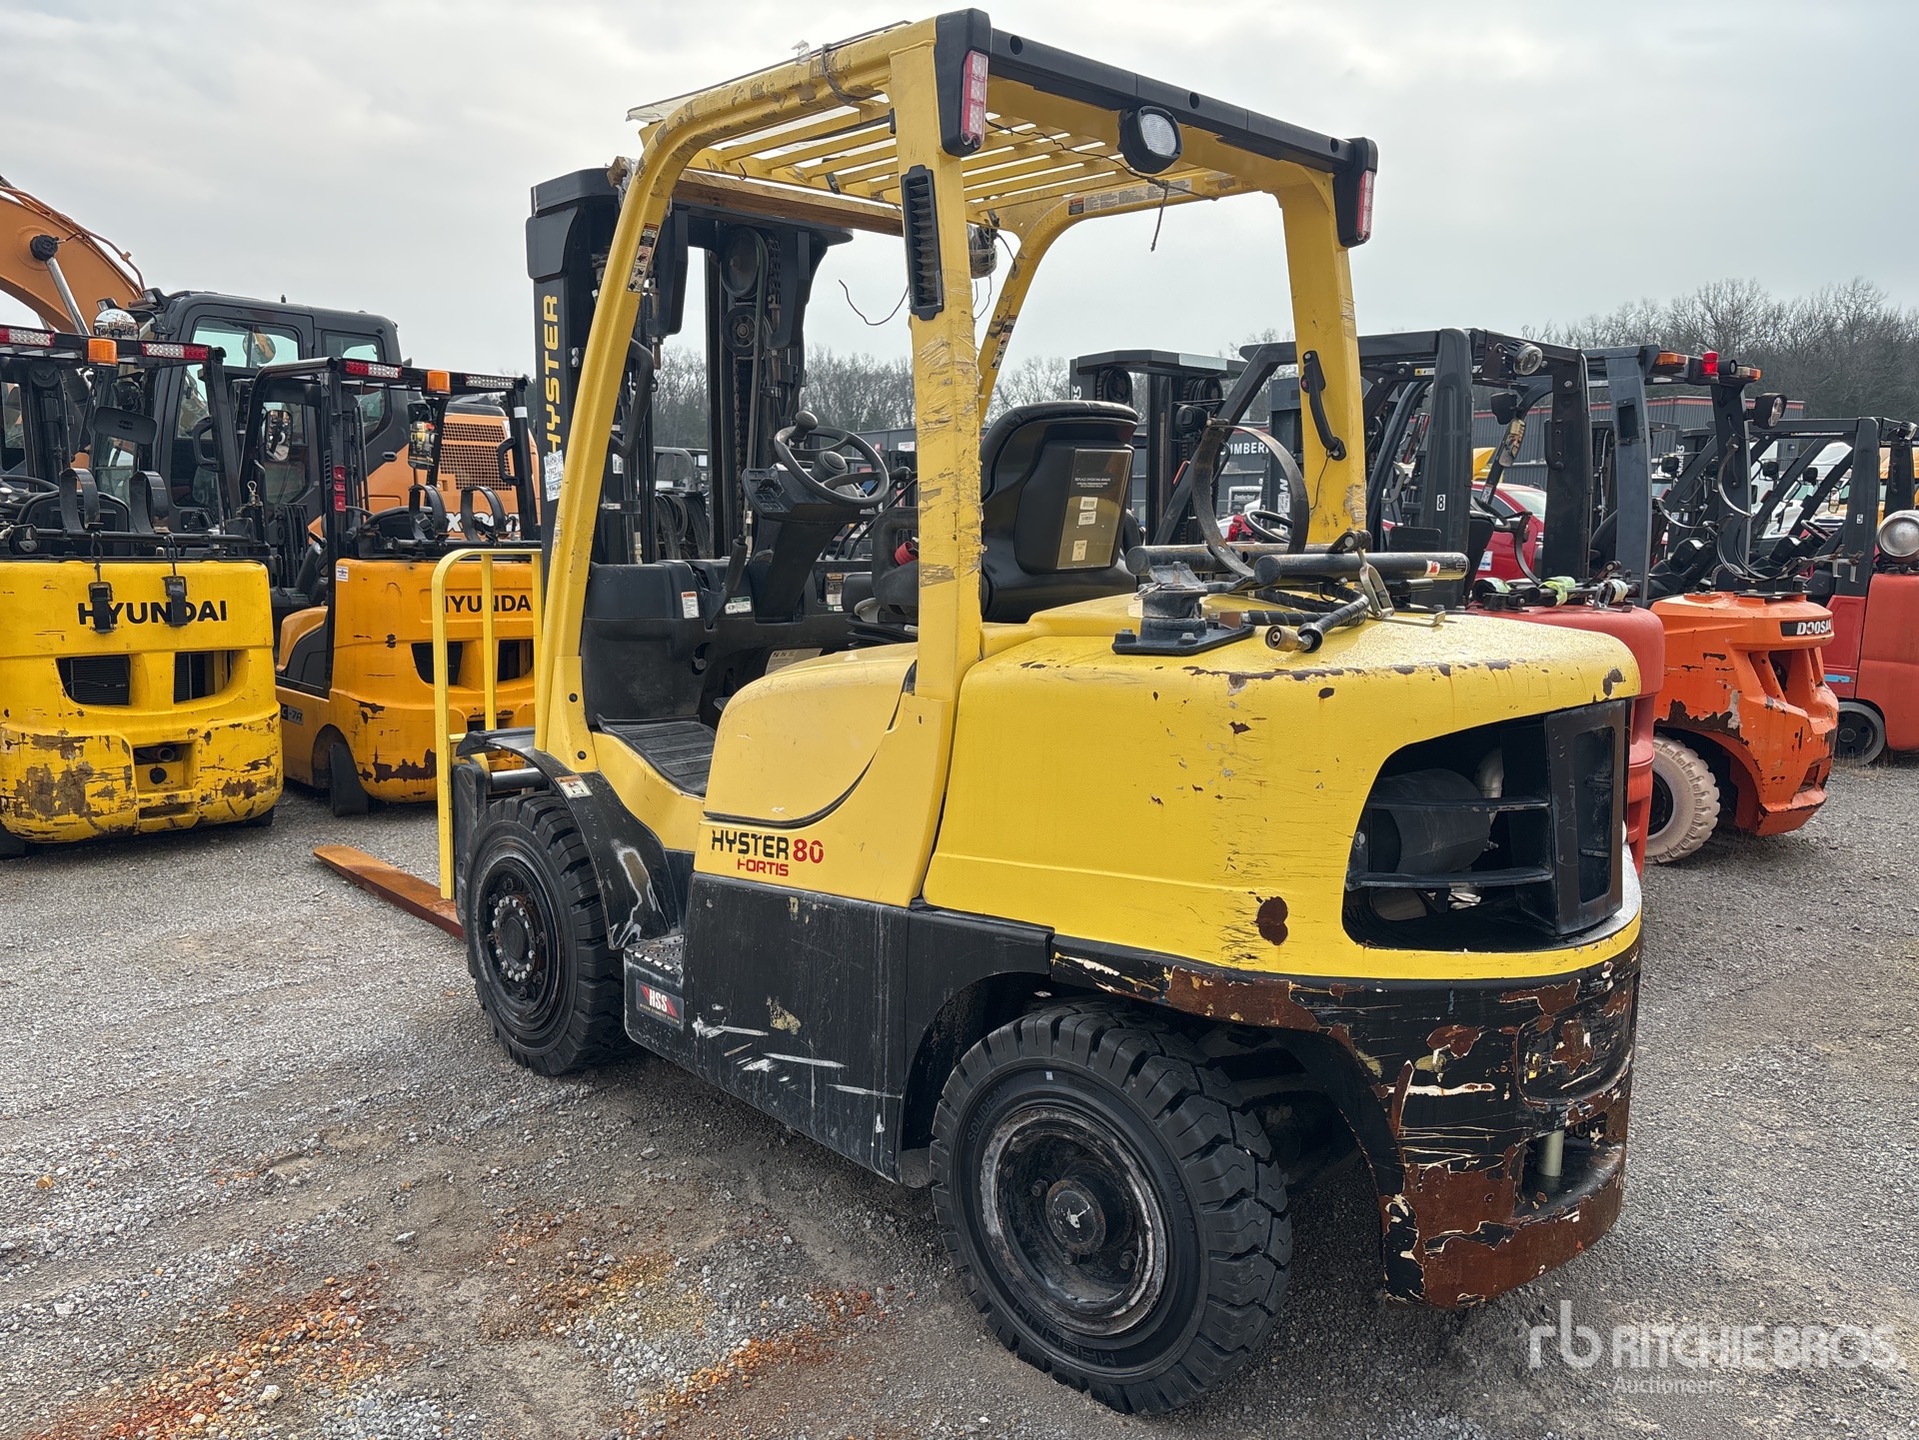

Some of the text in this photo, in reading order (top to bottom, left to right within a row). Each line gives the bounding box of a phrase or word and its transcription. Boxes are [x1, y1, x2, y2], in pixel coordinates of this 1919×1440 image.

[544, 295, 562, 455] HYSTER
[711, 829, 824, 864] HYSTER 80
[737, 857, 789, 877] FORTIS
[649, 988, 667, 1012] HSS
